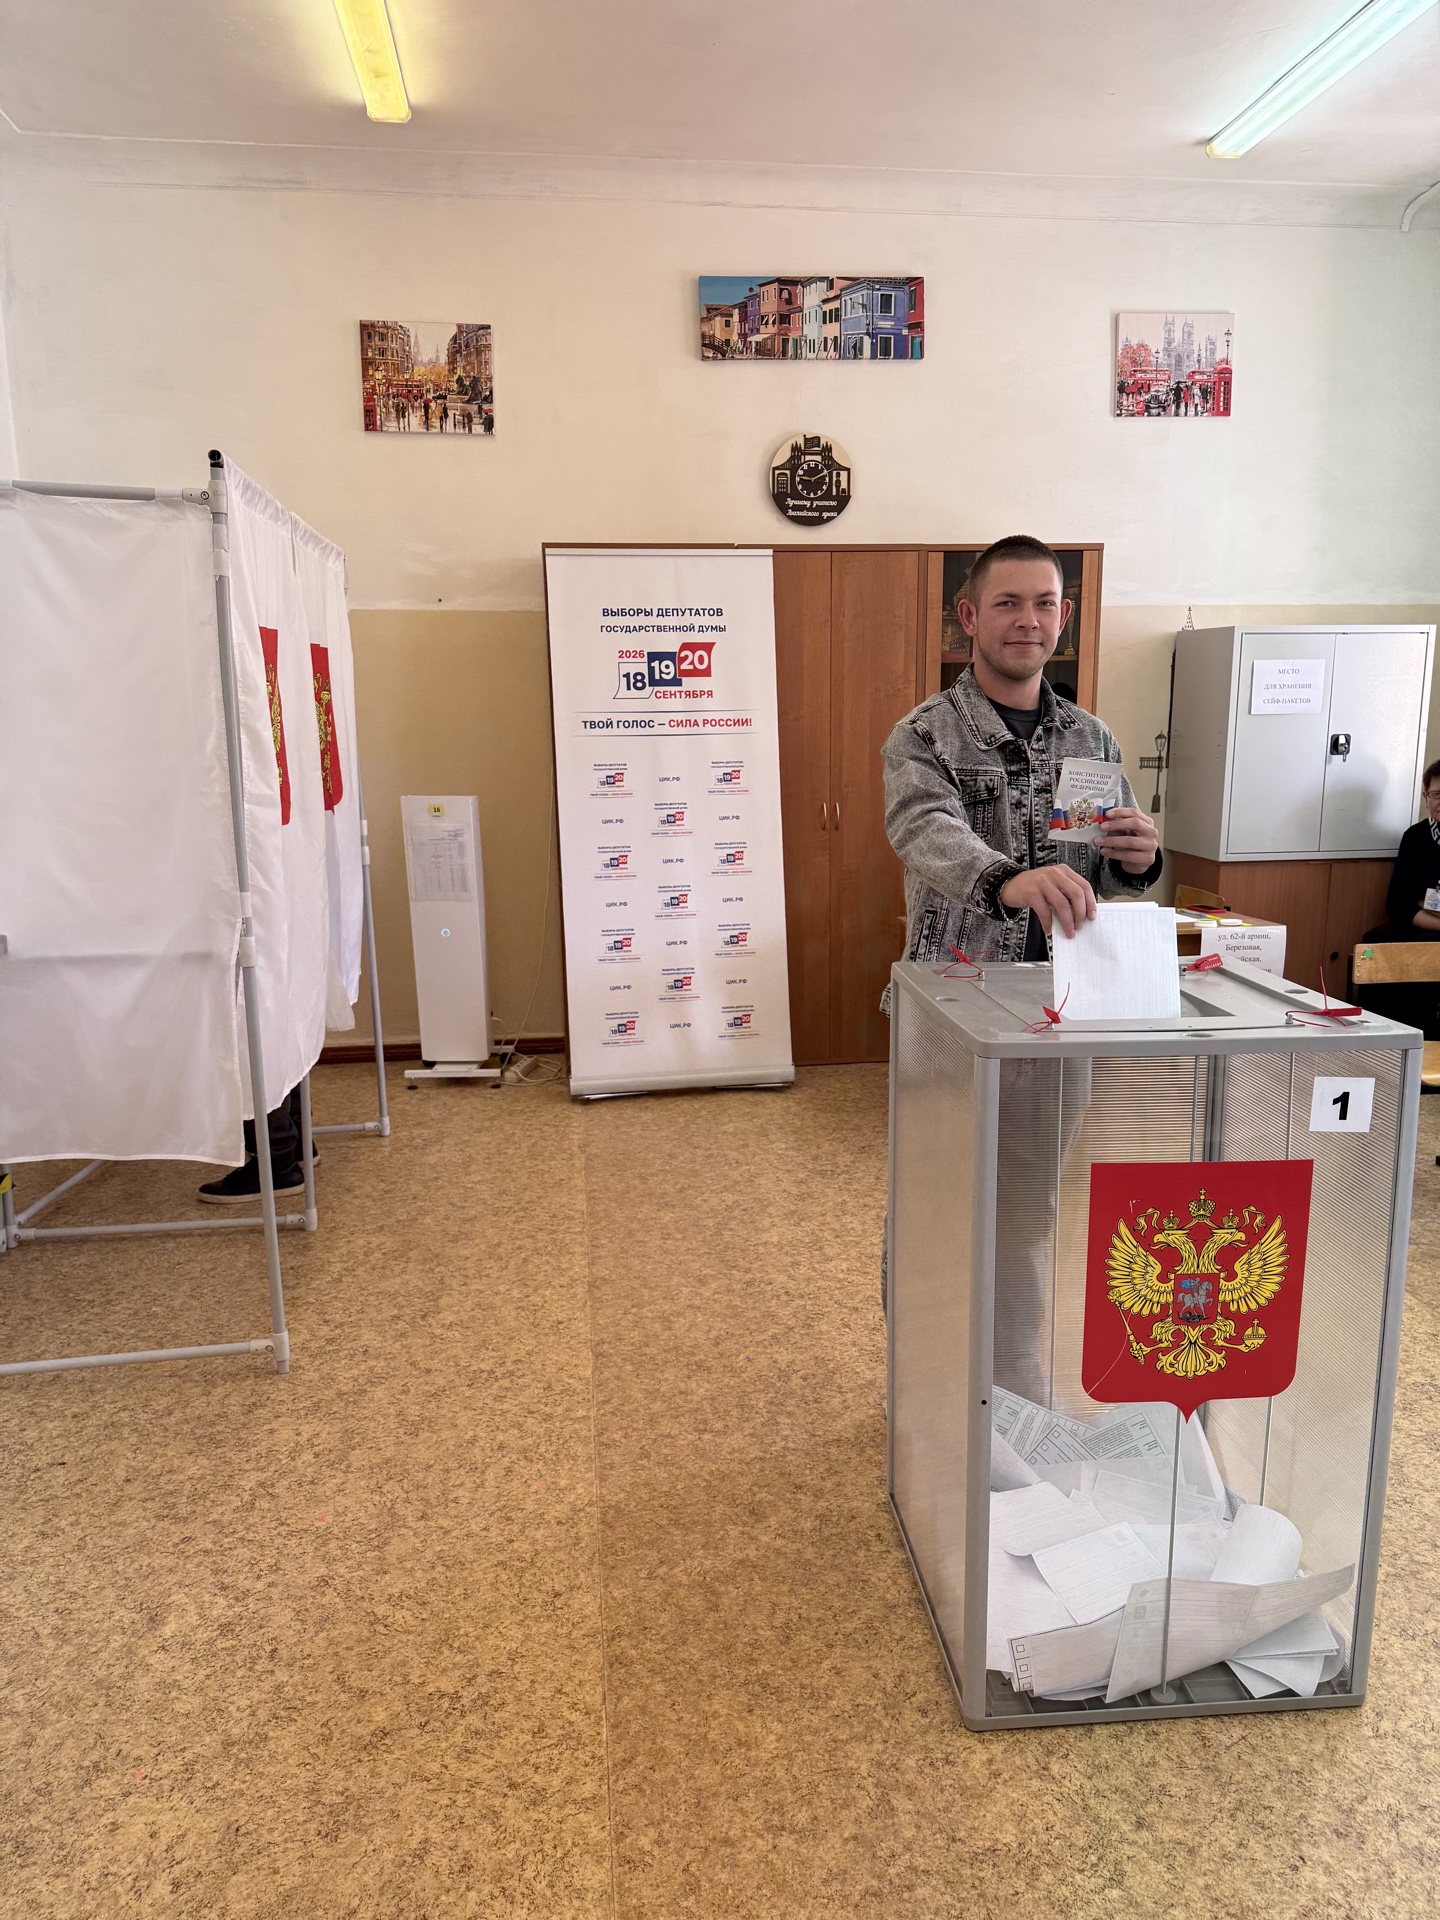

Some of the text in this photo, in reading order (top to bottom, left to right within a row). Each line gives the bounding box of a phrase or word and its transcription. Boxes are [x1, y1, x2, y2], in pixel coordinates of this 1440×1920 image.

[602, 608, 723, 618] ВЫБОРЫ ДЕПУТАТОВ
[600, 623, 726, 634] ГОСУДАРСТВЕННОЙ ДУМЫ
[618, 650, 645, 658] 2026
[622, 650, 708, 691] 18 19 20
[655, 690, 713, 699] СЕНТЯБРЯ
[582, 718, 614, 729] ТВОЙ
[616, 720, 655, 729] ГОЛОС
[668, 719, 700, 728] СИЛА
[703, 718, 752, 728] РОССИИ!
[1069, 770, 1112, 779] КОНСТИТУЦИЯ
[1070, 777, 1108, 785] РОССИЙСКОЙ
[1071, 784, 1104, 792] ФЕДЕРАЦИИ
[1225, 944, 1262, 952] Березовая,
[1332, 1091, 1350, 1120] 1
